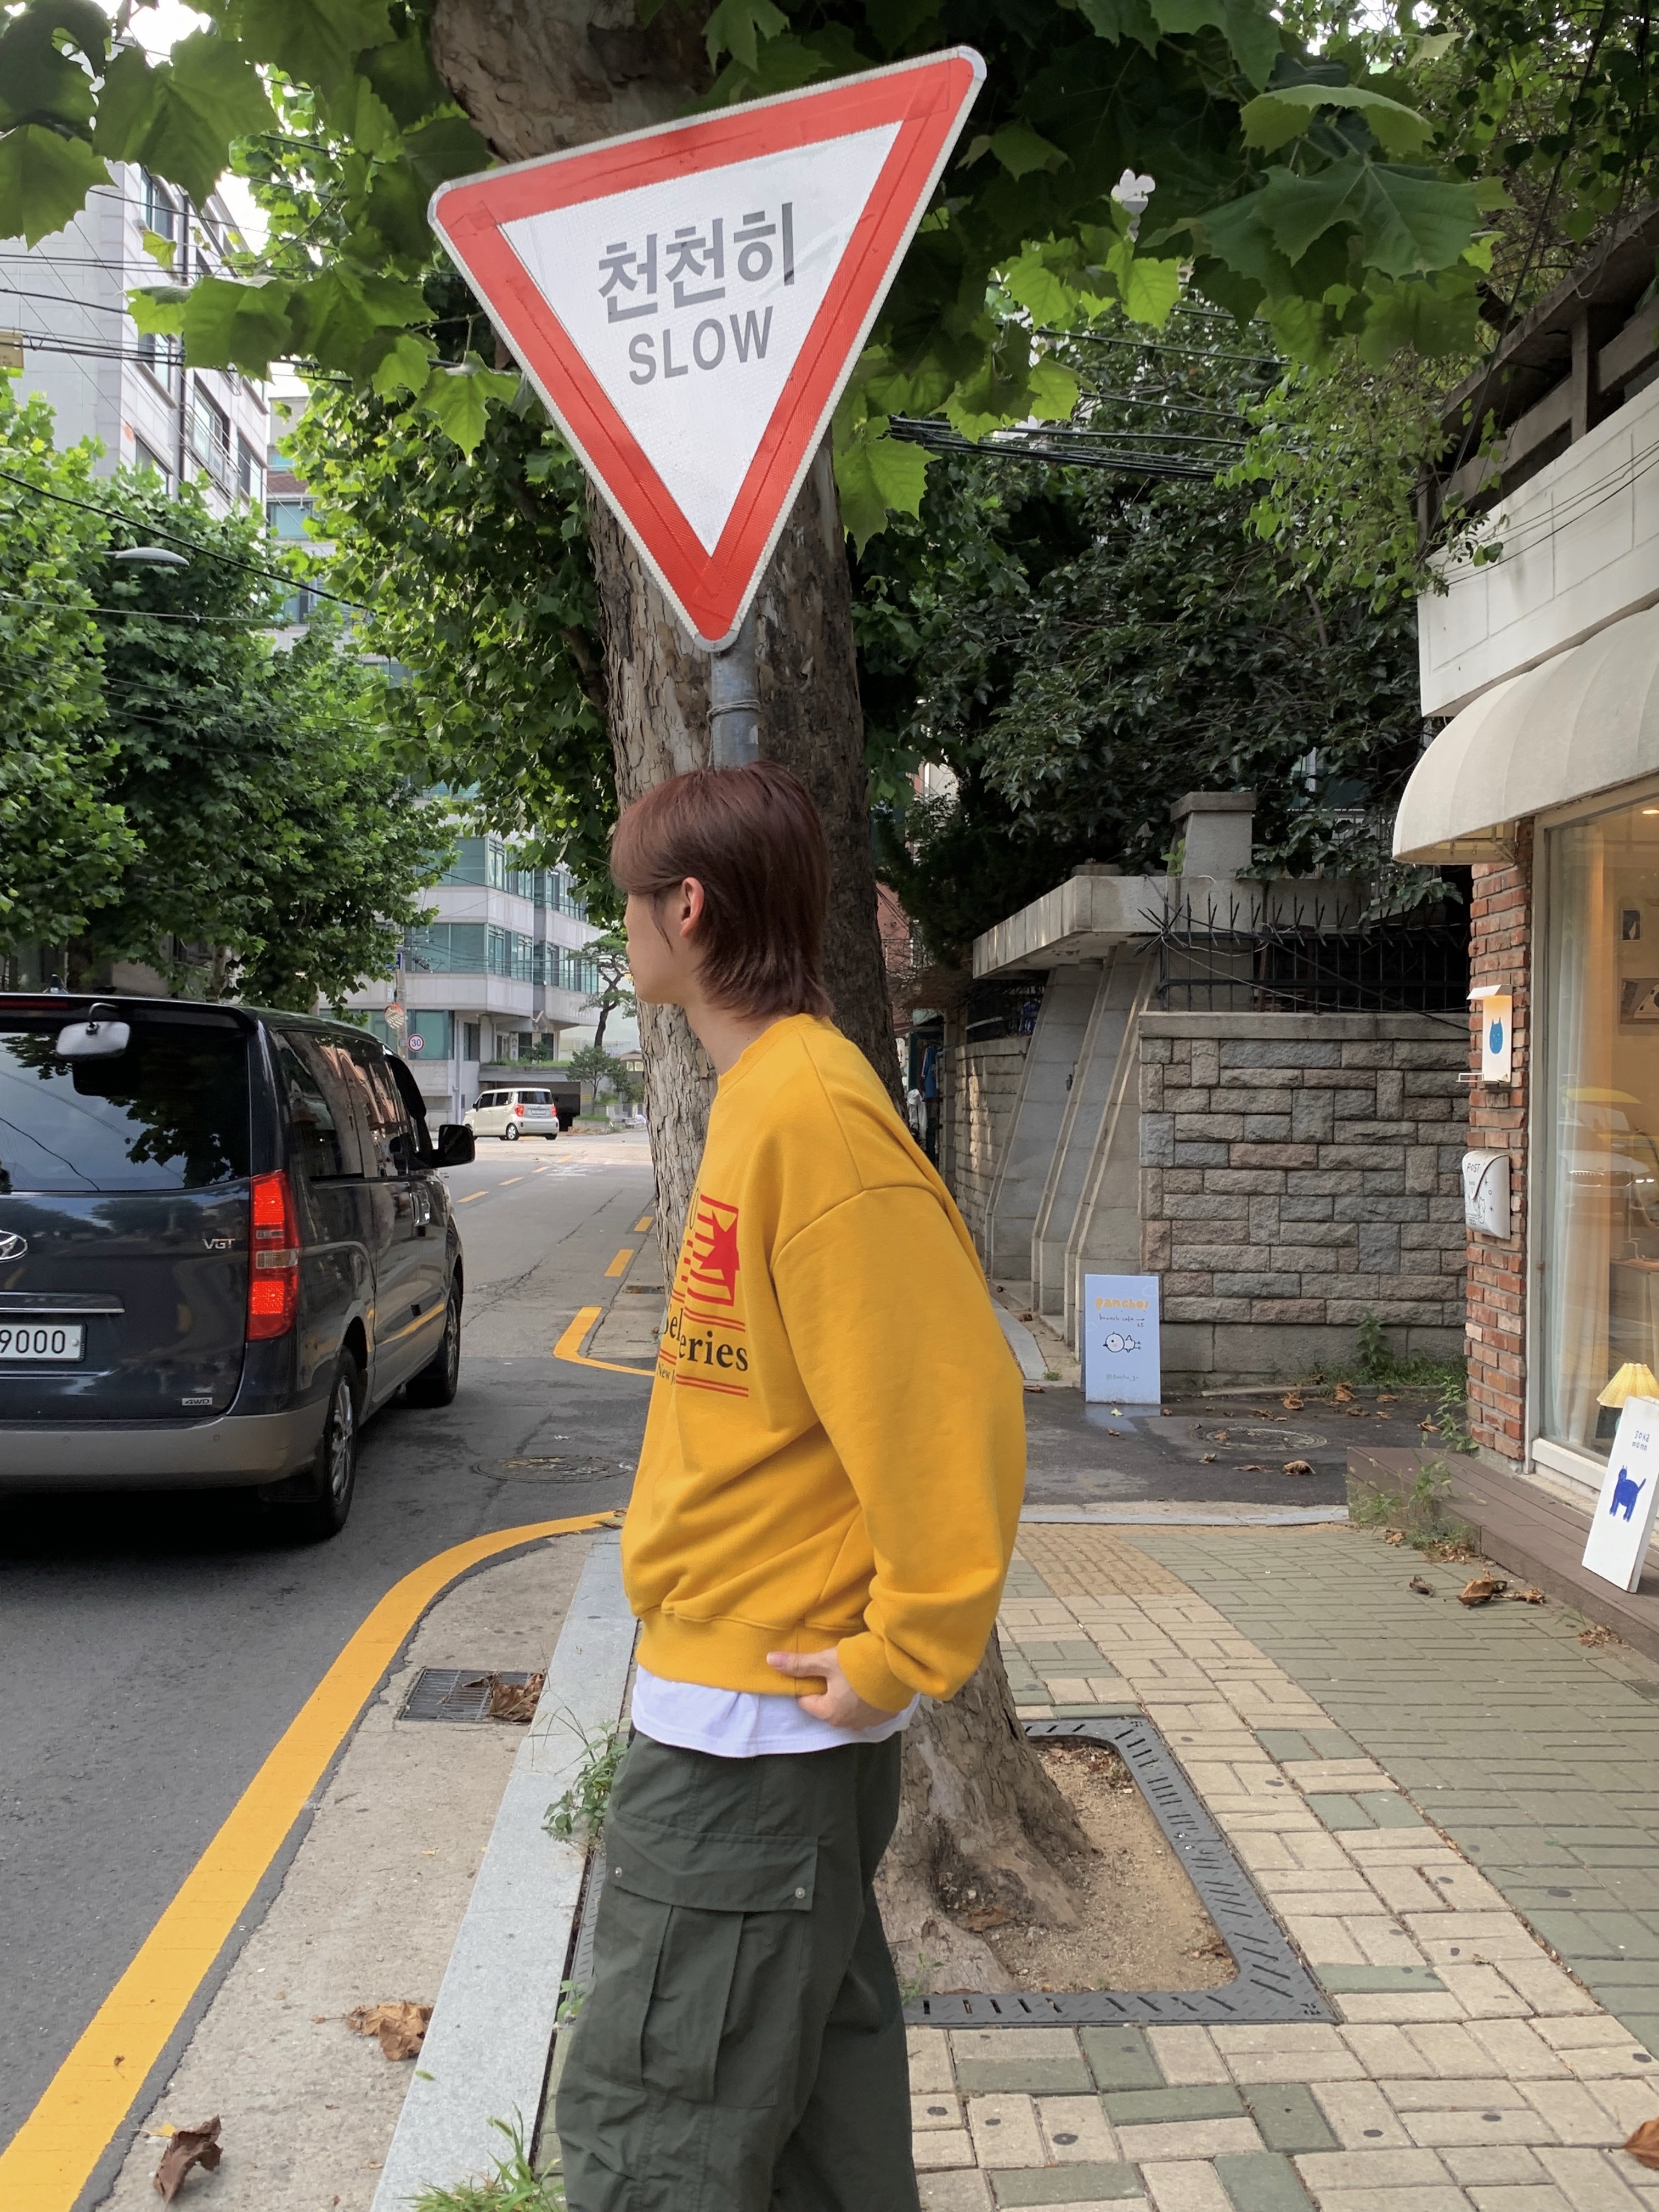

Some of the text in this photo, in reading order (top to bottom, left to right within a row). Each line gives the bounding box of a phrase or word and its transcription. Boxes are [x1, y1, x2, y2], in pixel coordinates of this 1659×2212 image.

[598, 201, 795, 324] 천천히
[628, 306, 774, 385] SLOW
[1466, 1163, 1481, 1172] POST
[202, 1238, 236, 1249] VGT
[0, 1330, 66, 1354] 9000
